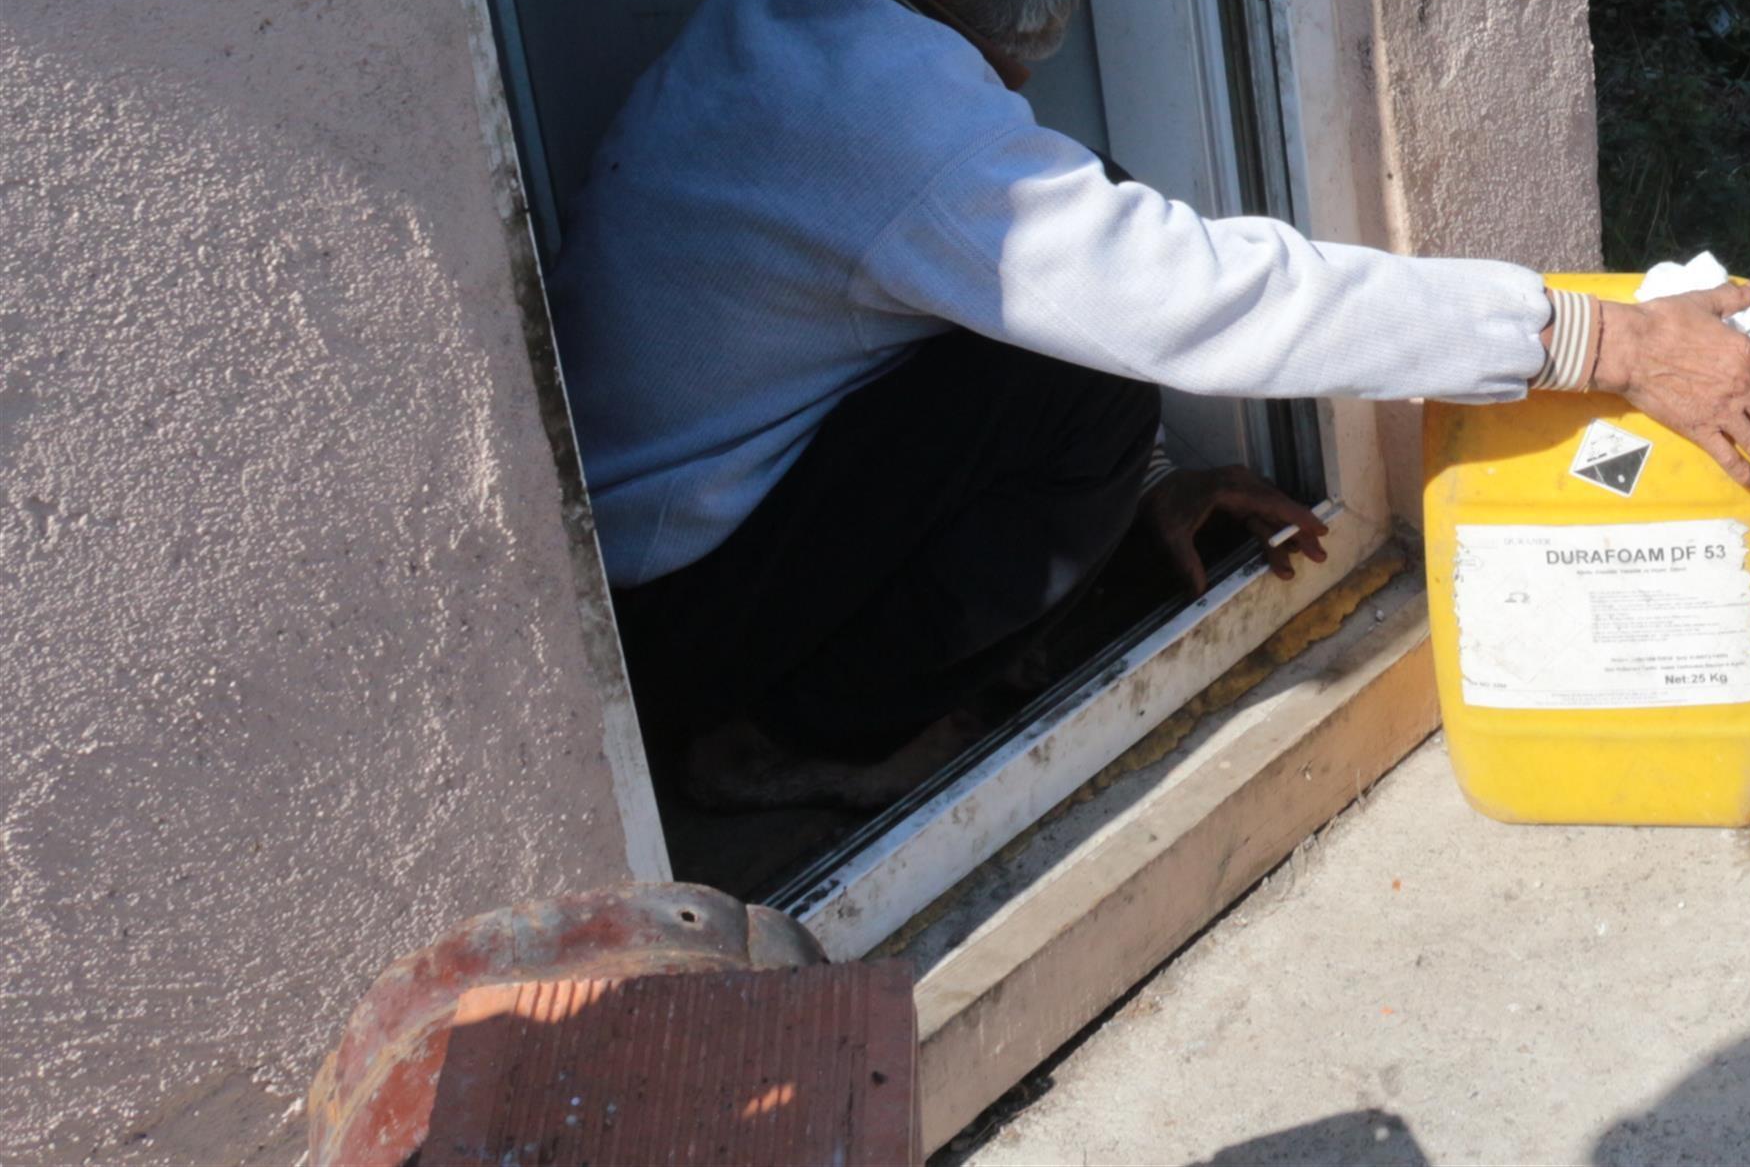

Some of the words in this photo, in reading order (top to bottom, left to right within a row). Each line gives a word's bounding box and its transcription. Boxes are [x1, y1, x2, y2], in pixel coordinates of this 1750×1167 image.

[1546, 547, 1665, 564] DURAFOAM
[1671, 545, 1696, 562] DF
[1704, 544, 1726, 559] 53
[1710, 673, 1728, 684] Kg
